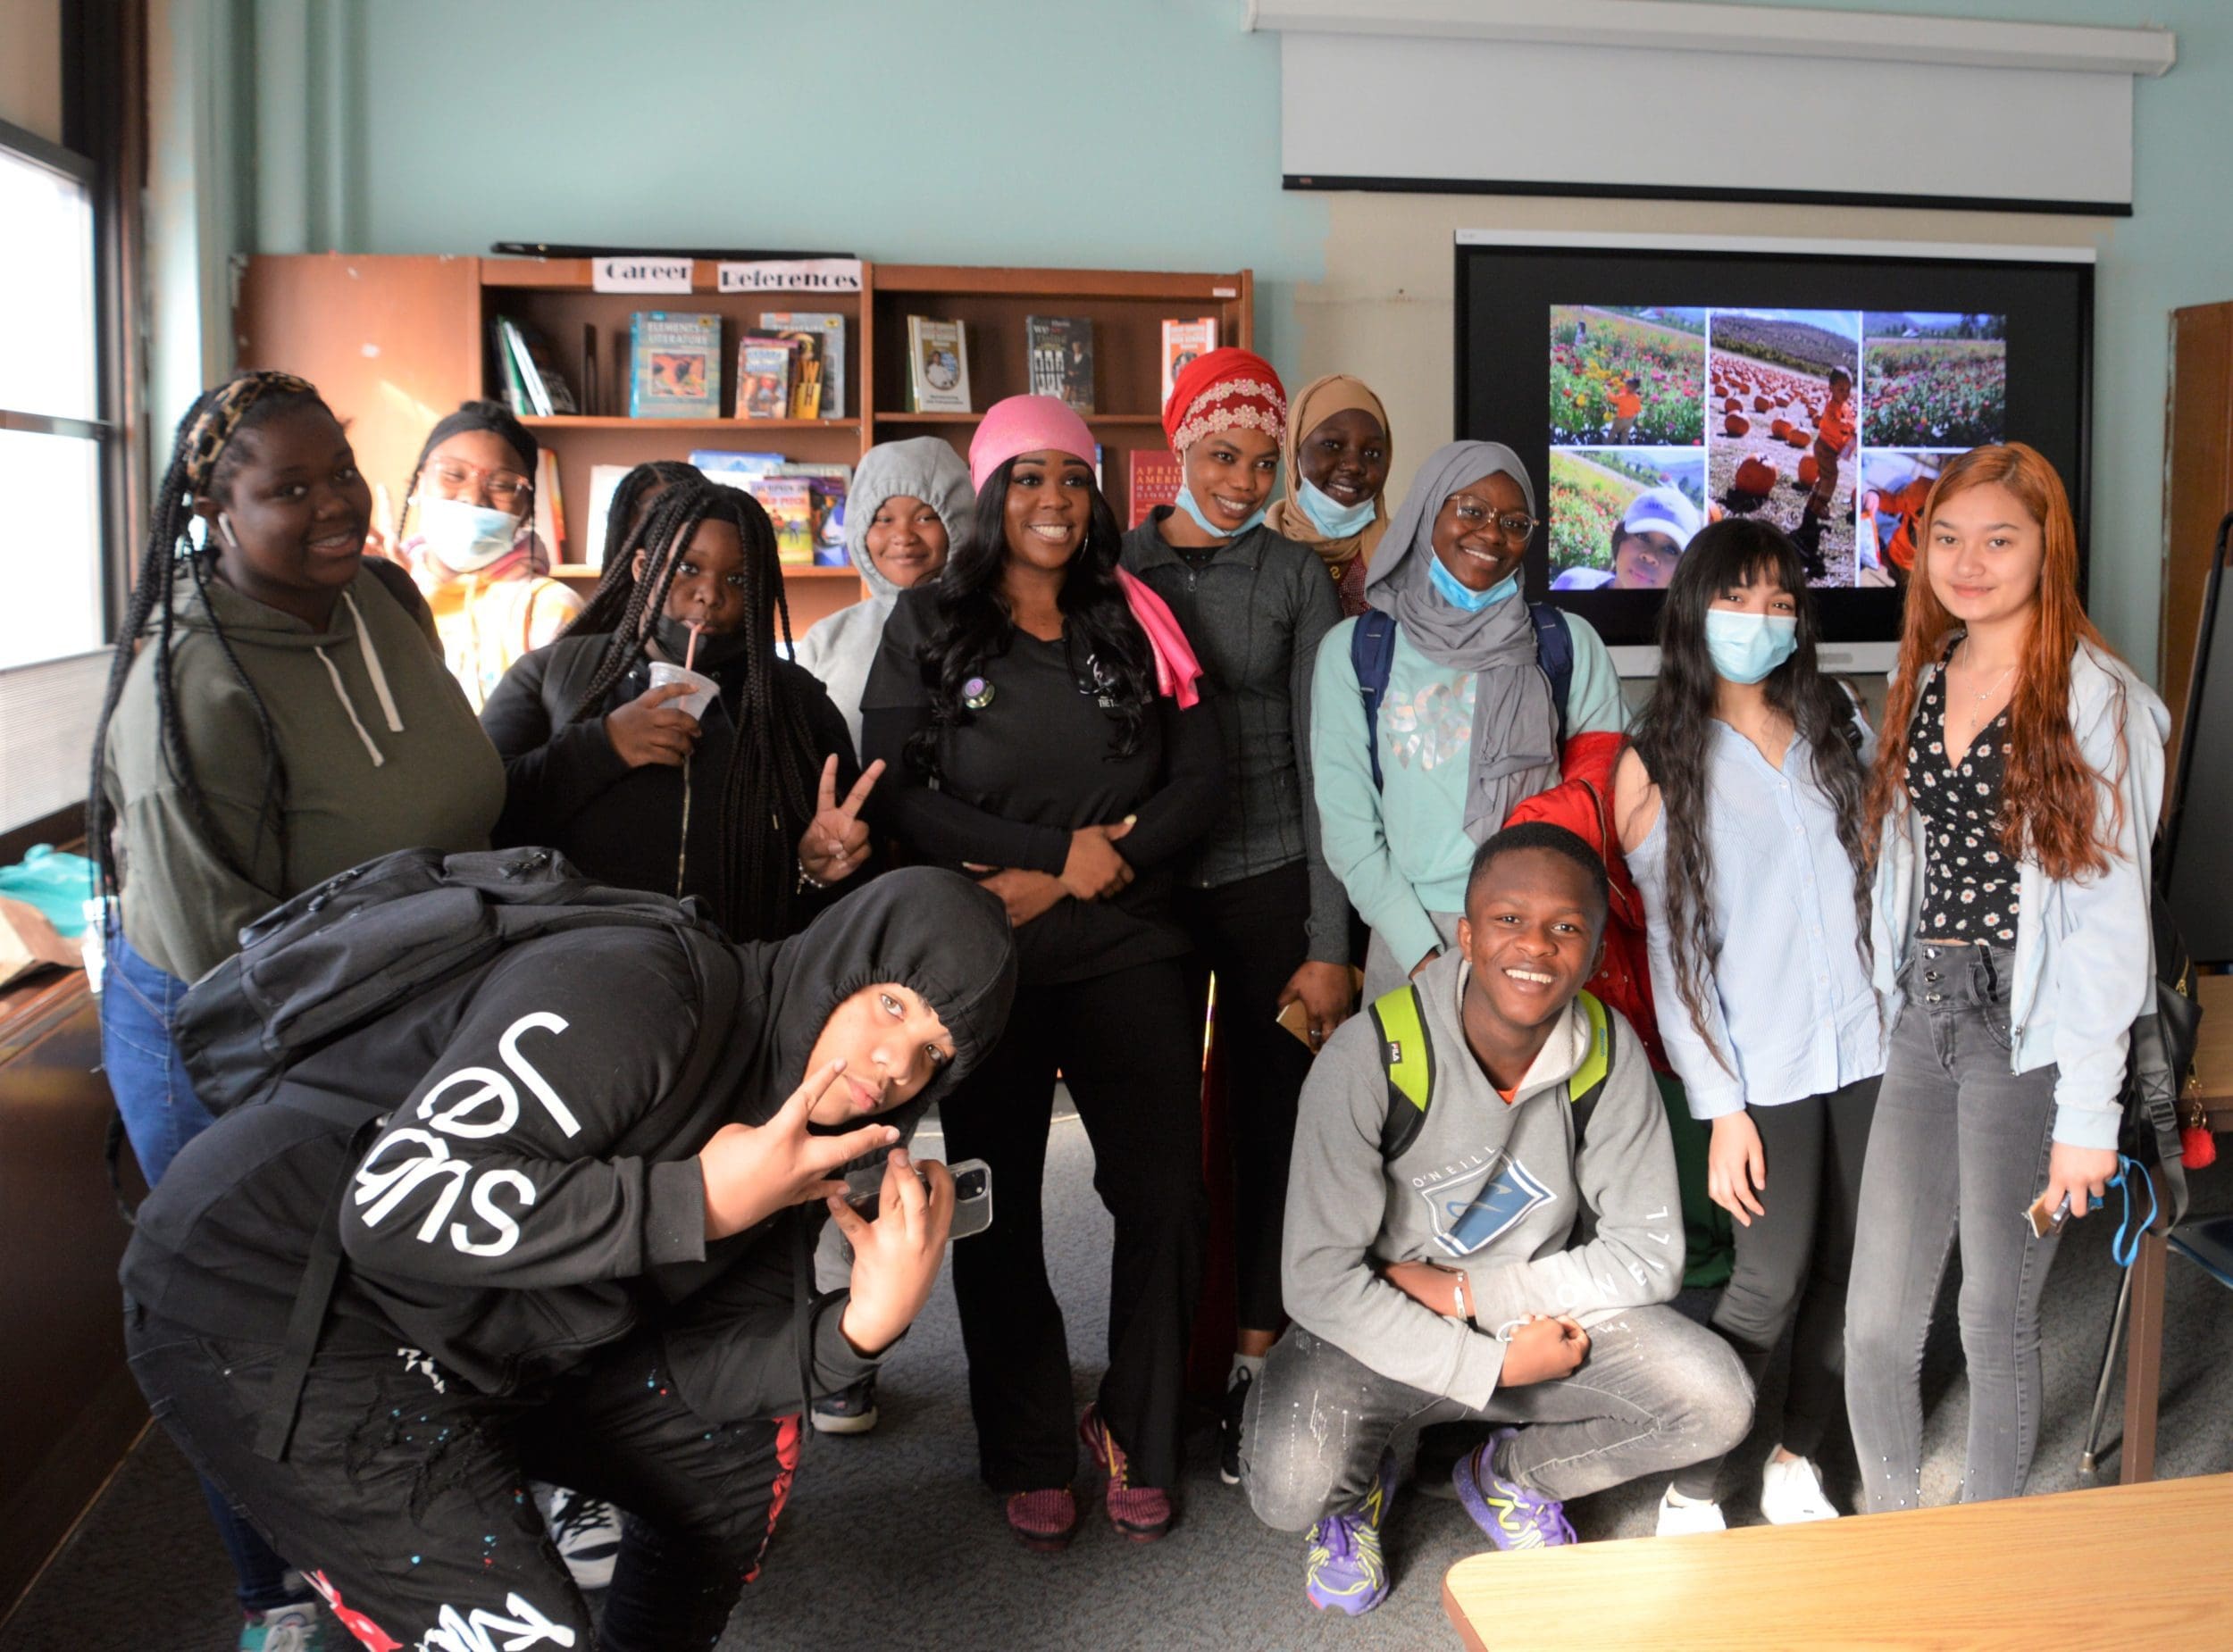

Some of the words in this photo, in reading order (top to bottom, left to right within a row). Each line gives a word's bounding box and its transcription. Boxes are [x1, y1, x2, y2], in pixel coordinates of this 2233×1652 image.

[605, 263, 689, 280] Career
[721, 270, 860, 288] References
[1135, 466, 1181, 475] AFRIC
[1136, 475, 1182, 484] AMERI
[1412, 1147, 1495, 1188] O'NEILL
[1556, 1206, 1670, 1308] ONEILL
